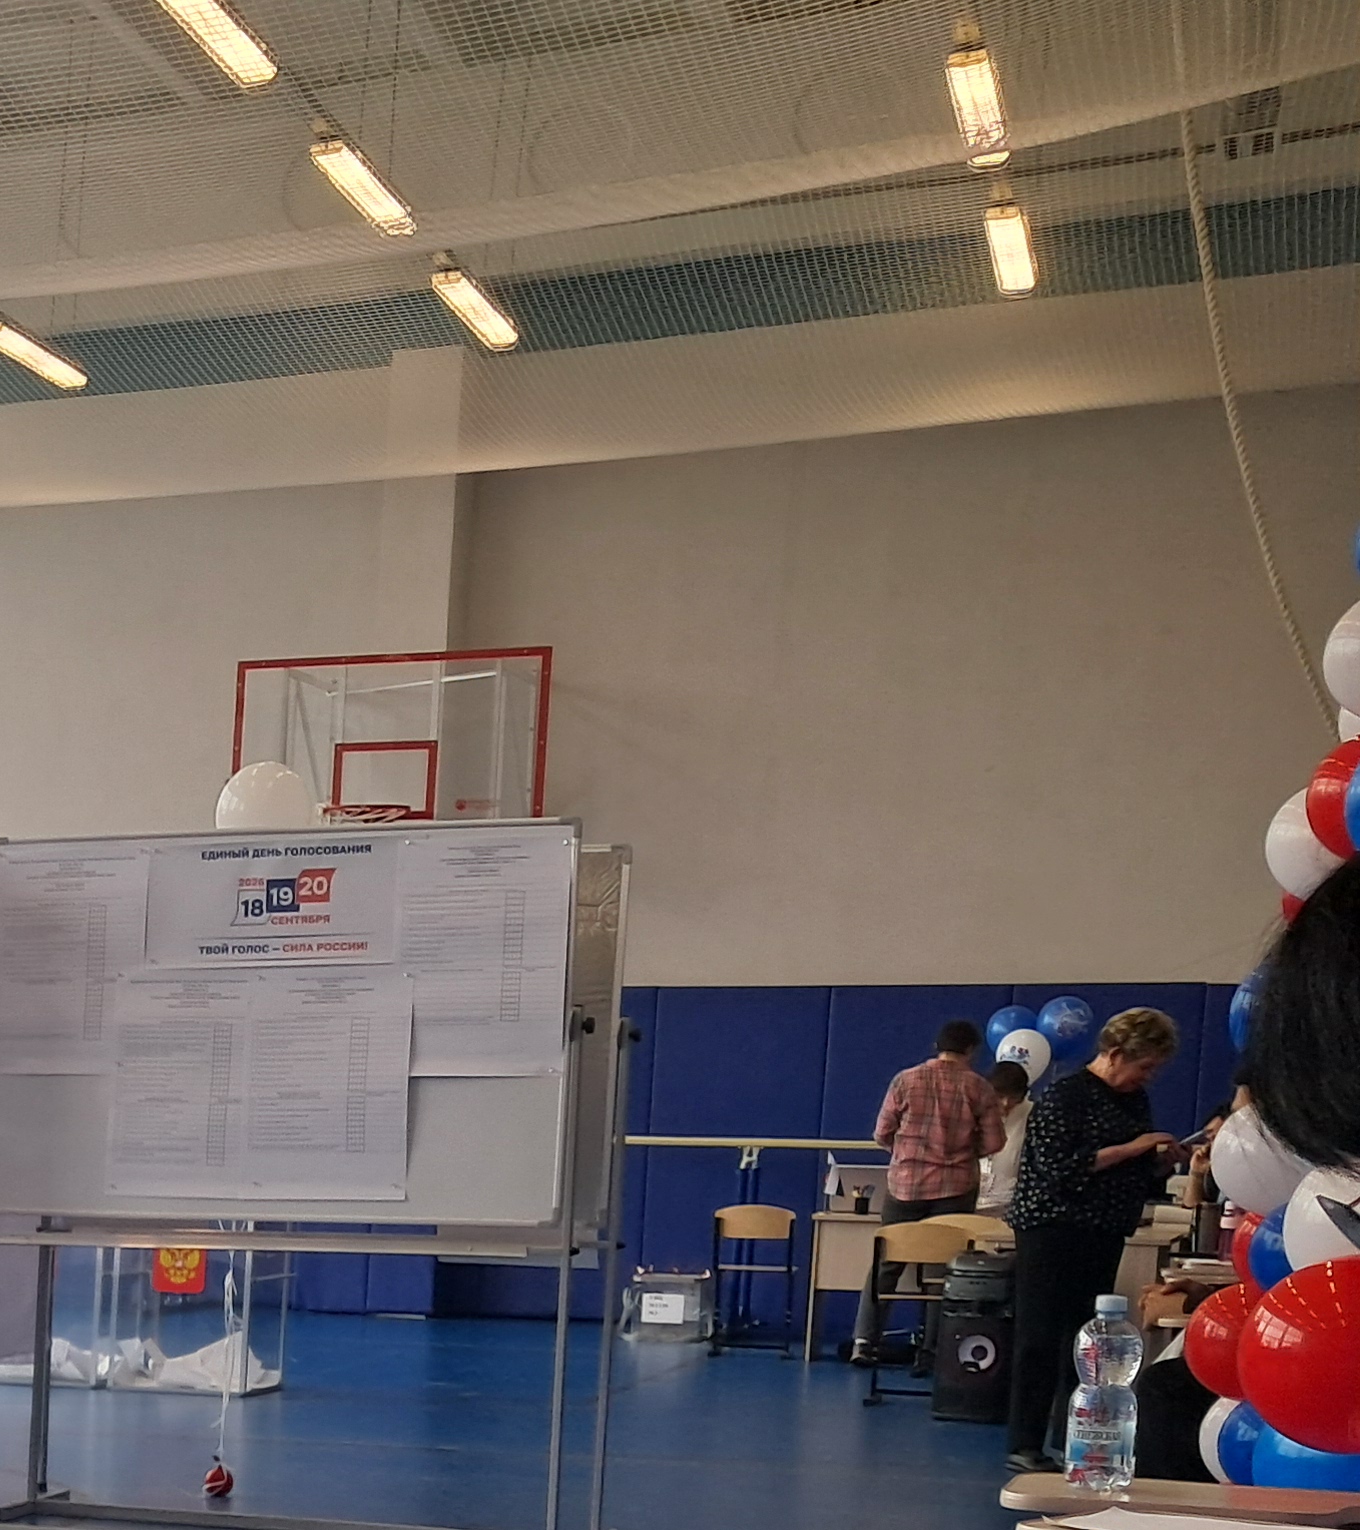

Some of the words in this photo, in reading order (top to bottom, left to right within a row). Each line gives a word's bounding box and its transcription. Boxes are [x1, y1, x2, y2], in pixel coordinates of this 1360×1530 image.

[201, 847, 250, 861] ЕДИНЫЙ
[252, 847, 282, 859] ДЕНЬ
[284, 844, 372, 857] ГОЛОСОВАНИЯ
[298, 876, 329, 896] 20
[269, 886, 294, 906] 19
[240, 898, 264, 918] 18
[270, 914, 331, 926] СЕНТЯБРЯ
[198, 944, 229, 955] ТВОЙ
[232, 944, 270, 954] ГОЛОС
[282, 944, 314, 953] СИЛА
[316, 942, 368, 952] РОССИИ!
